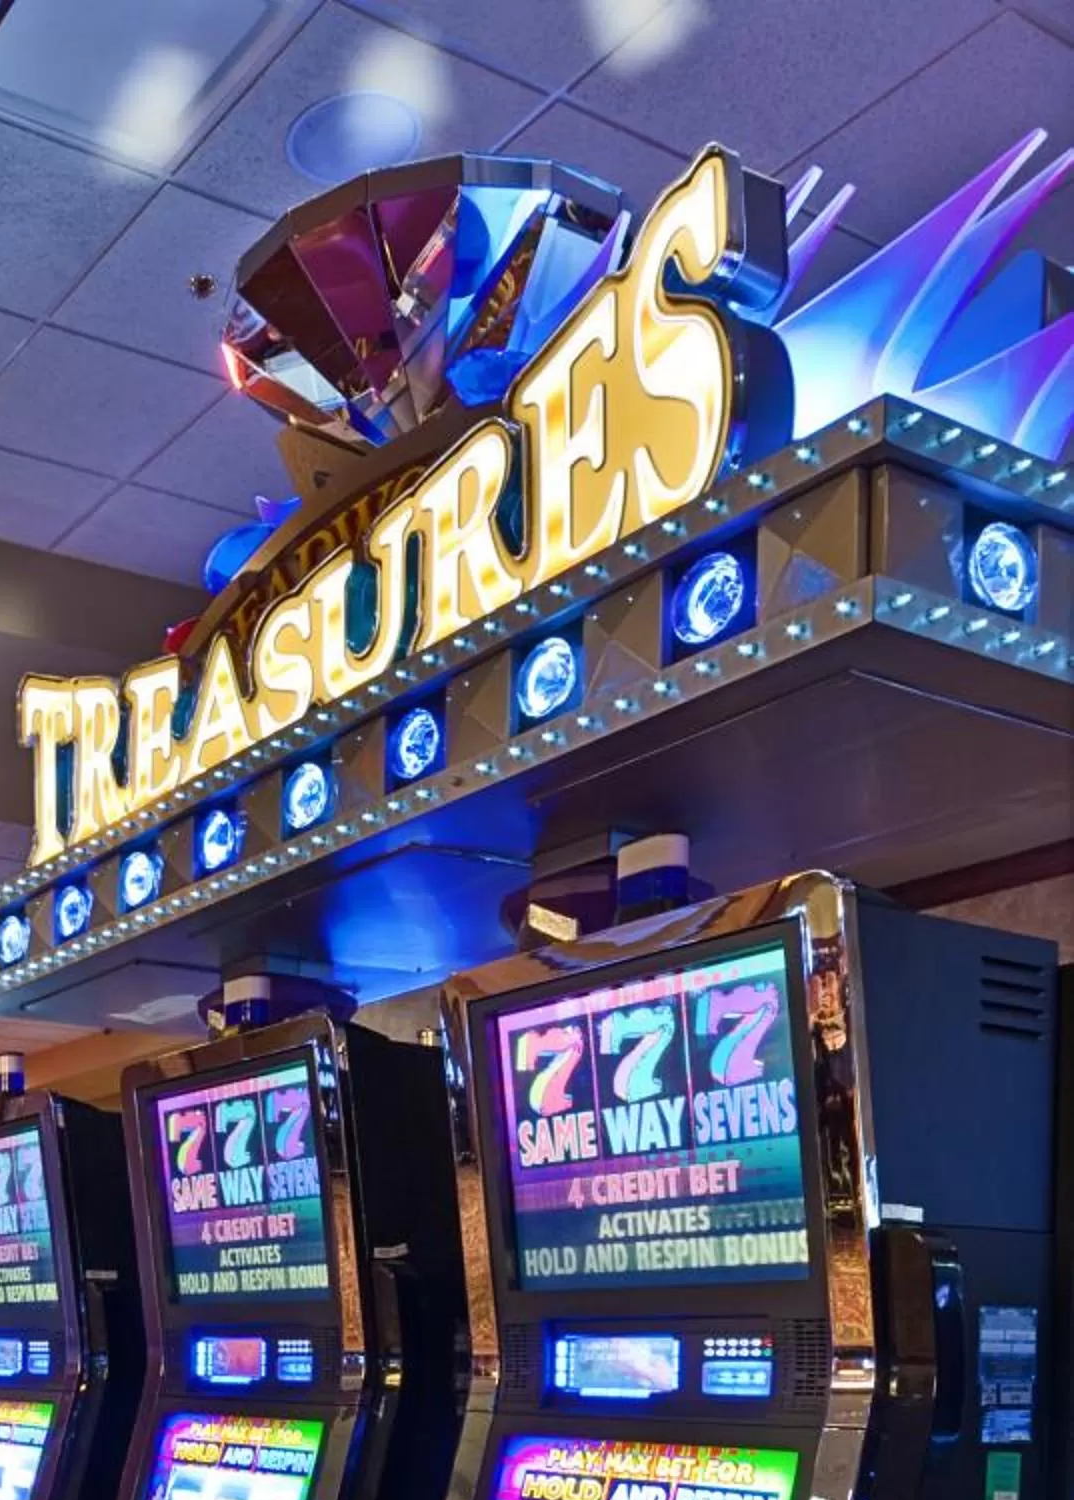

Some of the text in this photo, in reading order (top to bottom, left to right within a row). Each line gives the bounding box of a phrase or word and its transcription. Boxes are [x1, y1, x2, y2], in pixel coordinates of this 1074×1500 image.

[20, 146, 730, 867] TREASURES
[517, 1078, 797, 1167] SAME WAY SEVENS
[171, 1173, 219, 1213] SAME
[219, 1166, 265, 1206] WAY
[568, 1160, 741, 1208] 4 CREDIT BET
[201, 1213, 296, 1245] 4 CREDIT BET
[598, 1206, 711, 1239] ACTIVATES
[219, 1245, 281, 1268] ACTIVATES
[525, 1229, 809, 1277] HOLD AND RESPIN BONUS
[546, 1449, 755, 1483] PLAY MAX BET FOR
